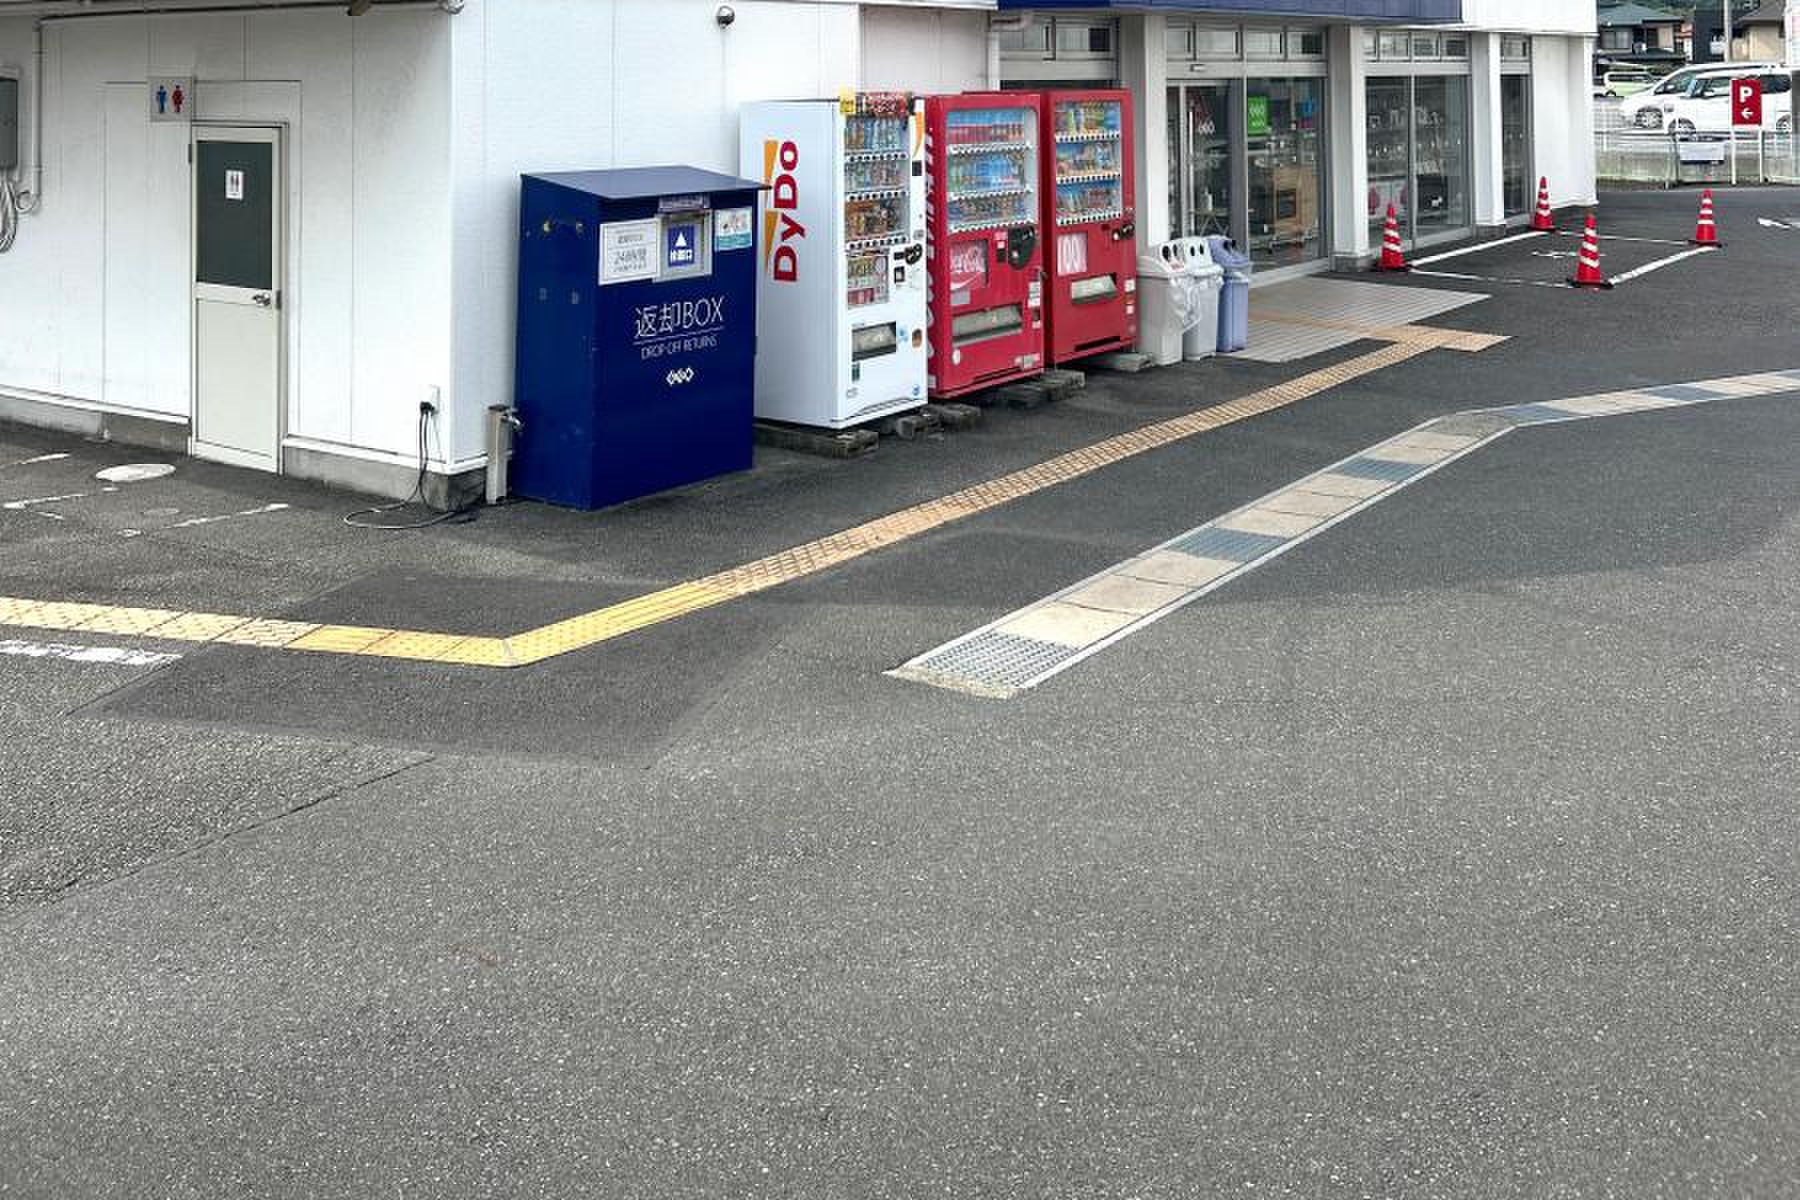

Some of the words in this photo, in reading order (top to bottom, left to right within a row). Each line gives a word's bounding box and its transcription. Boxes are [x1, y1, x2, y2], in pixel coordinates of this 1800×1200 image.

[1739, 86, 1753, 103] P
[773, 141, 806, 281] DyDo
[634, 296, 725, 339] 返却BOX
